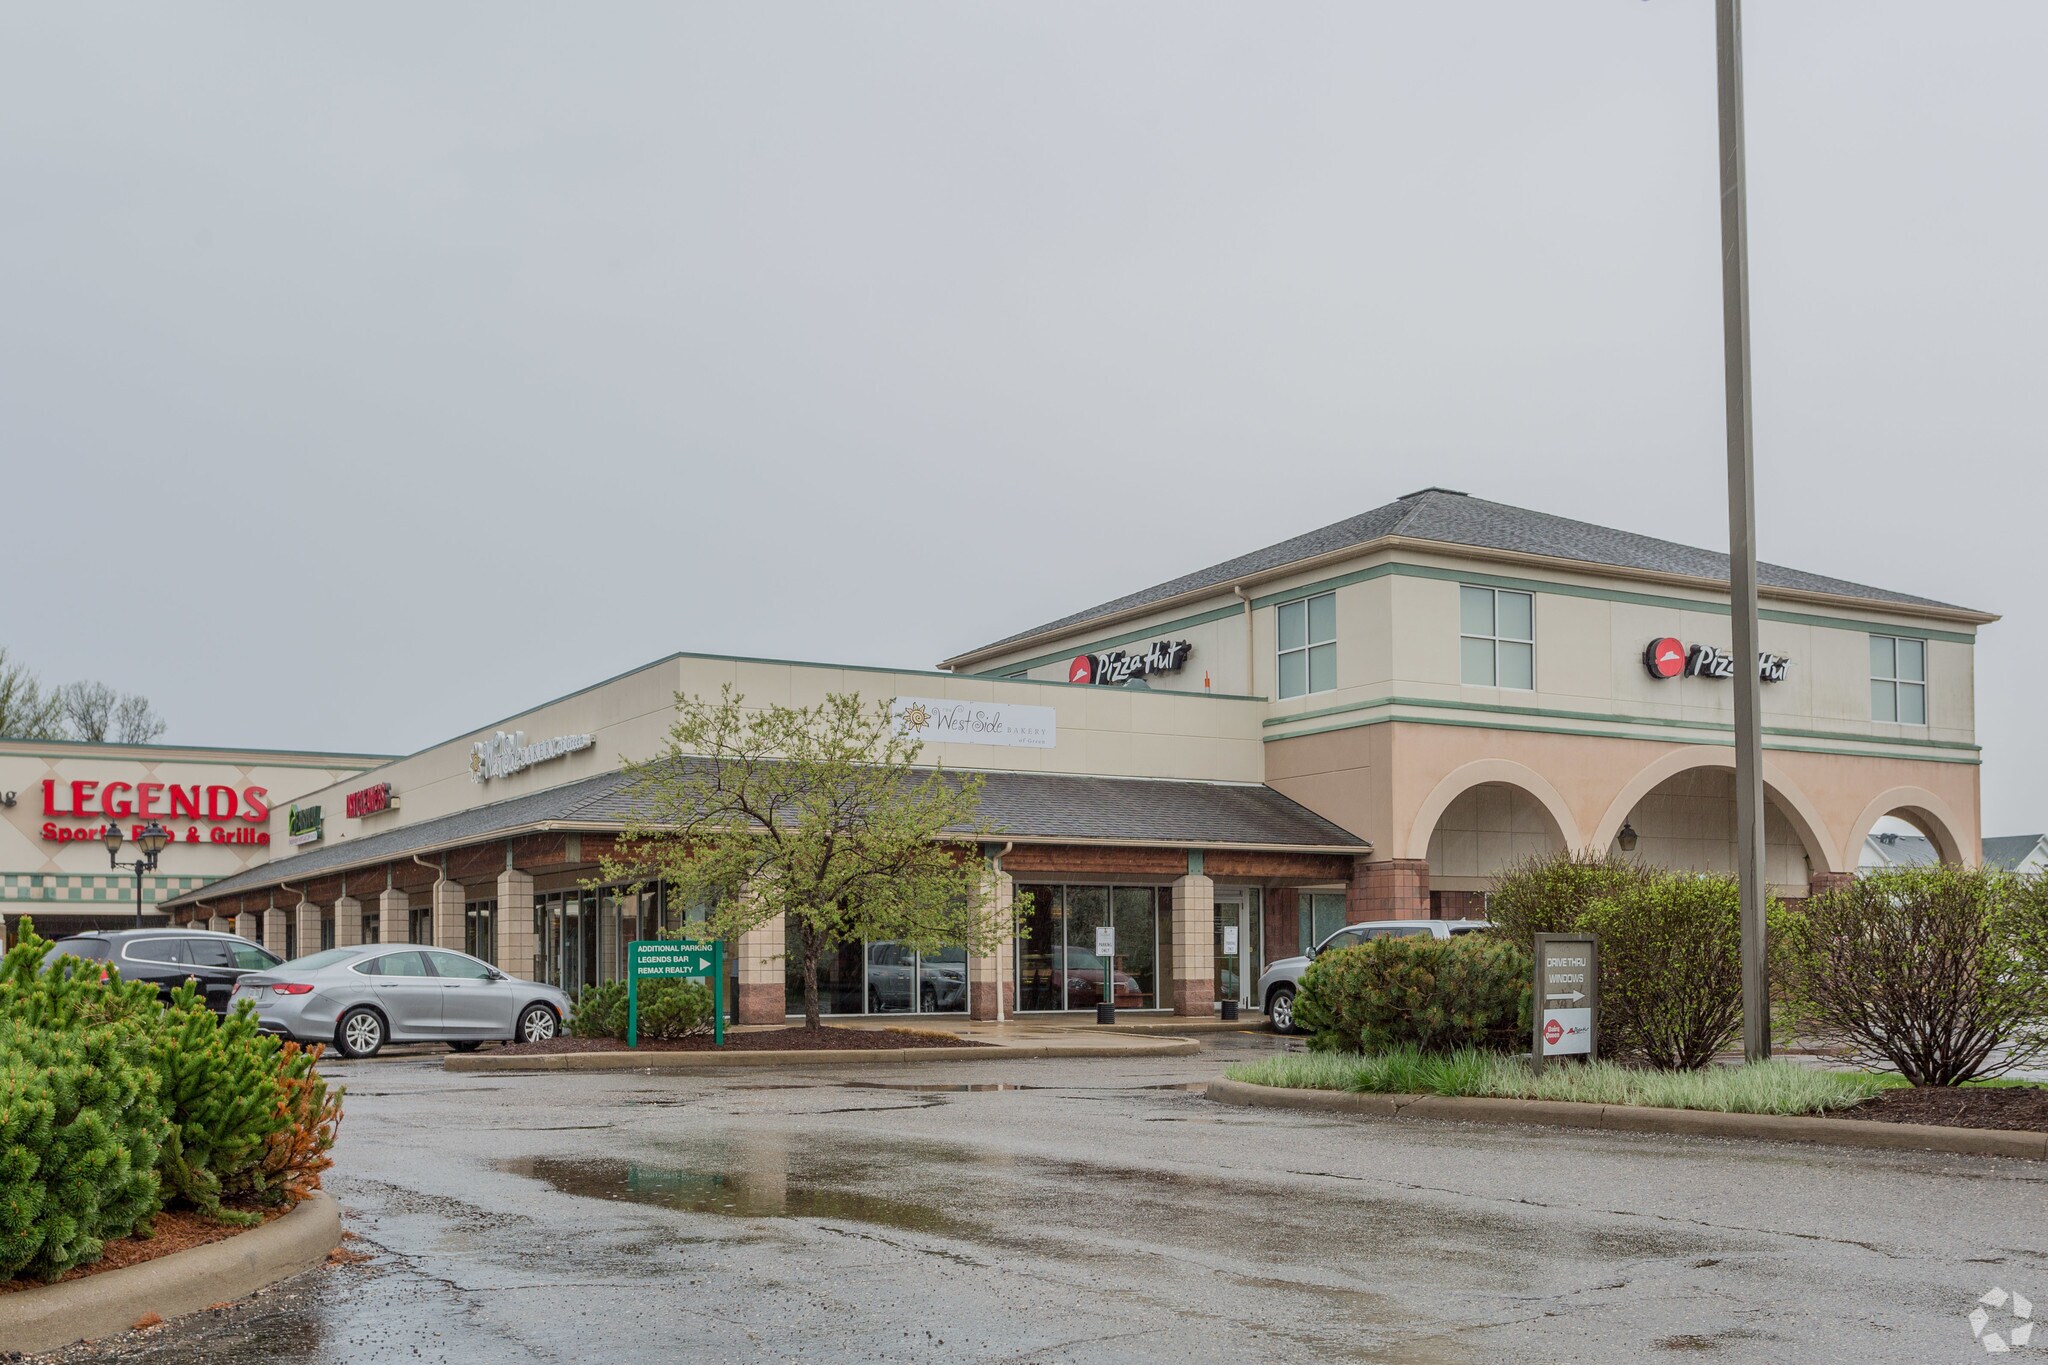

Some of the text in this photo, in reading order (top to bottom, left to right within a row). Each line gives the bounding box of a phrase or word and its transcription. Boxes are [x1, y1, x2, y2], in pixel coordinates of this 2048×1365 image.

[1096, 642, 1182, 686] Pizza Hut
[1694, 645, 1793, 680] Piz Hut
[1007, 727, 1047, 736] BAKERY
[521, 740, 557, 766] BAKERY
[42, 779, 269, 823] LEGENDS
[42, 822, 107, 844] Sport
[131, 824, 175, 844] Pb
[186, 826, 201, 844] &
[210, 826, 270, 845] Grille
[637, 945, 679, 953] ADDITIONAL
[637, 966, 694, 975] REMAX REALTY
[1546, 957, 1587, 968] DRIVE THRU
[1548, 973, 1584, 984] WINDOWS
